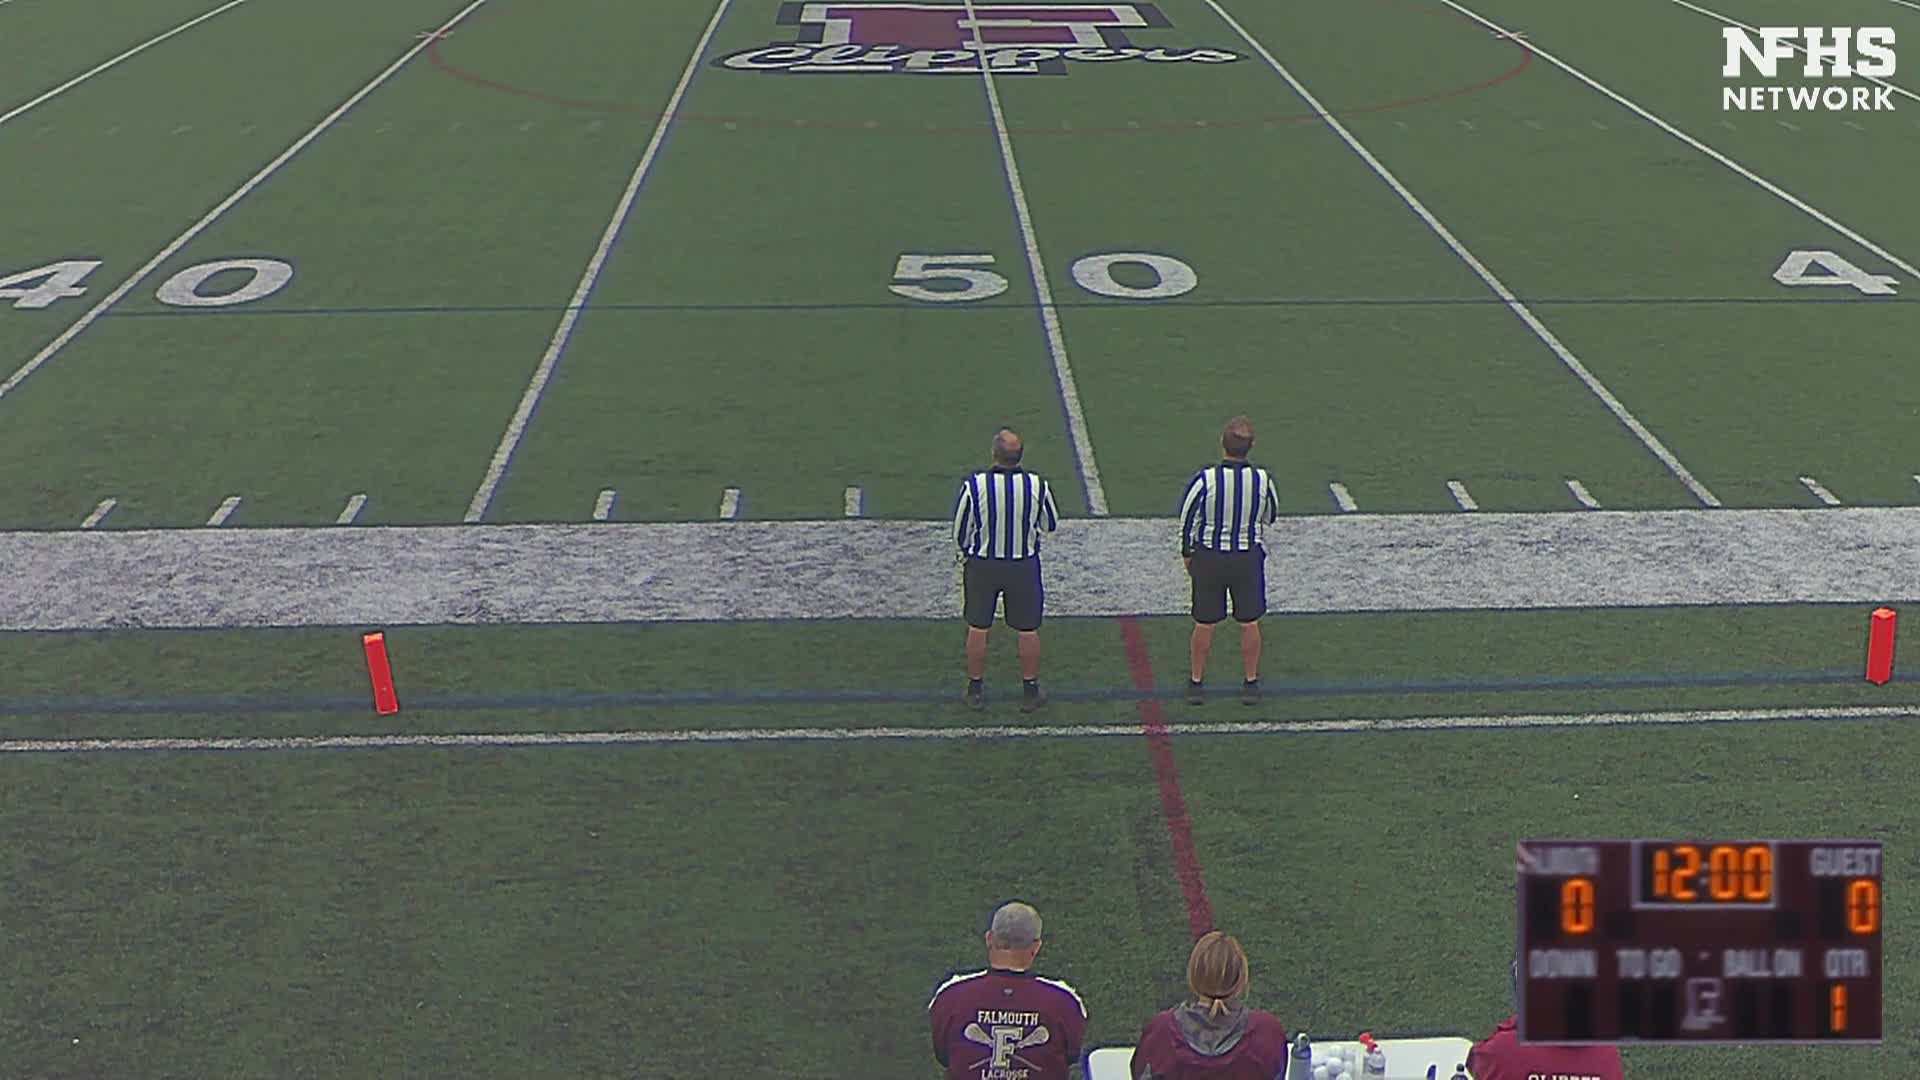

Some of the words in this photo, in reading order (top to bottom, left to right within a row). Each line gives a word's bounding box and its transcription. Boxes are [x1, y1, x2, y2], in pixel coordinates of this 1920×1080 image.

[723, 43, 1238, 72] Clippers
[977, 1010, 1040, 1026] FALMOUTH
[990, 1025, 1024, 1070] F
[980, 1068, 1030, 1080] LACROSSE
